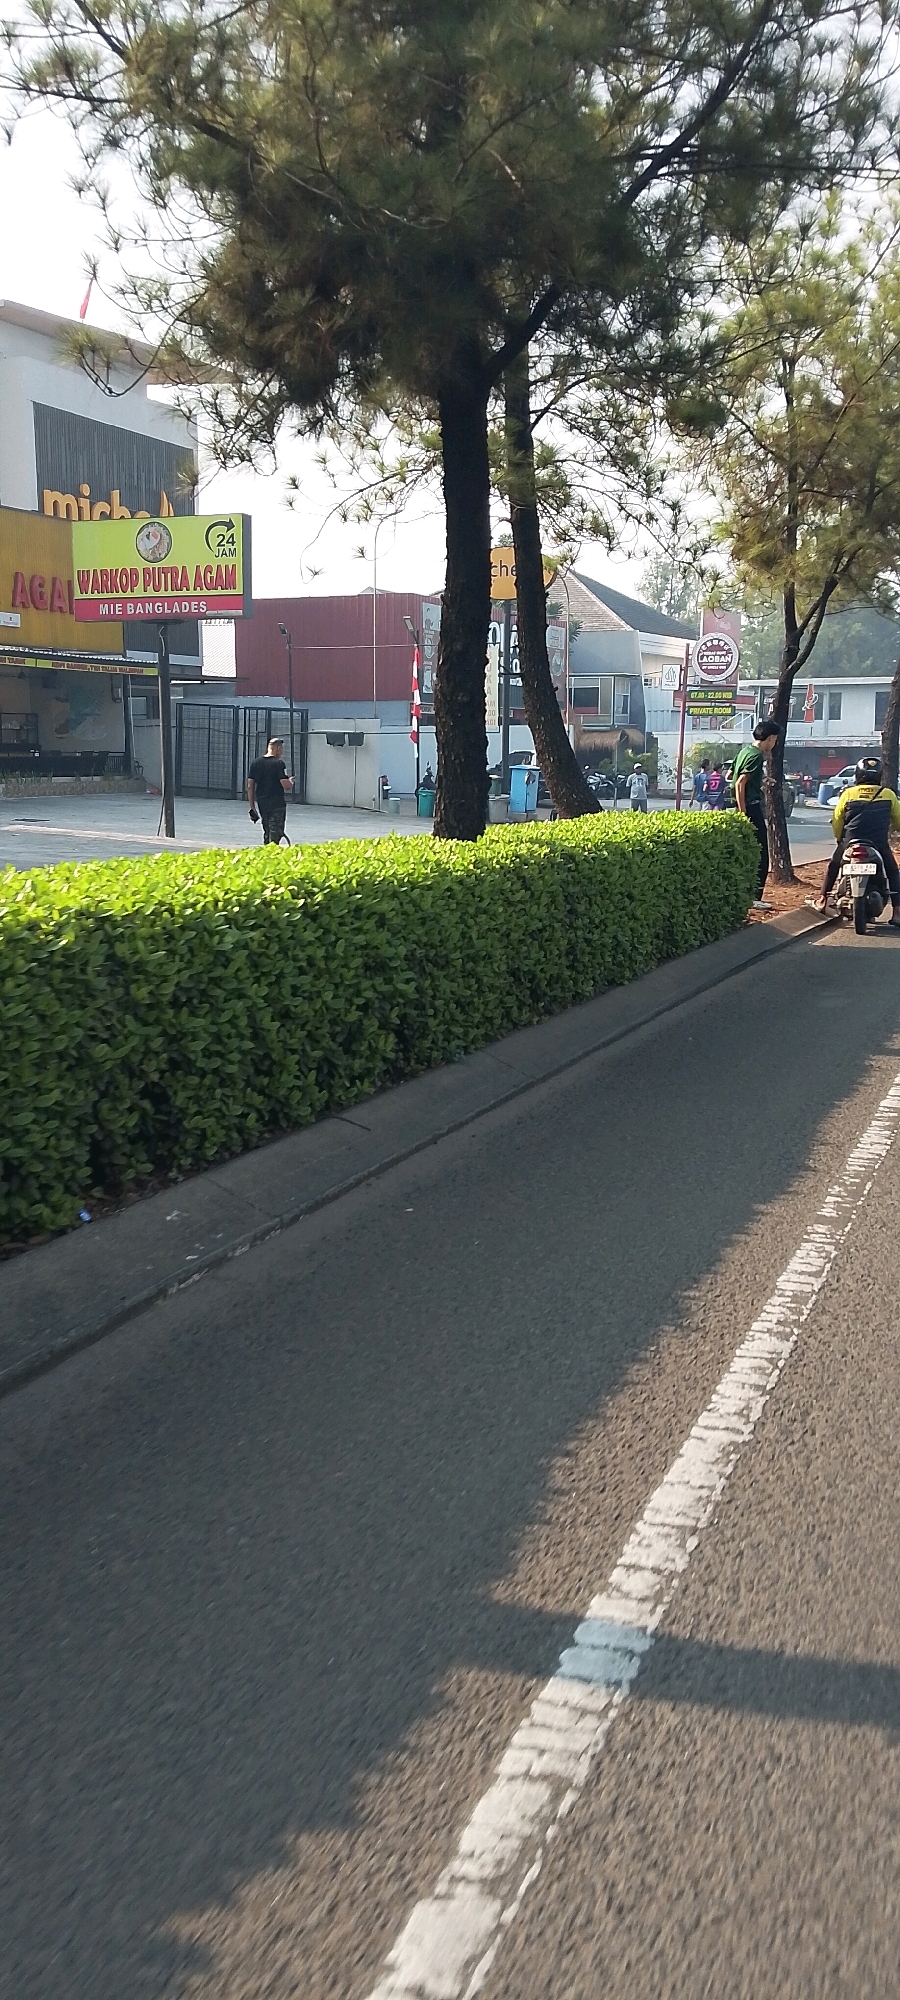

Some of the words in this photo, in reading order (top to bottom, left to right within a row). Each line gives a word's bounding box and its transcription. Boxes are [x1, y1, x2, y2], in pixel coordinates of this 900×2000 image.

[216, 533, 236, 548] 24
[214, 548, 237, 558] JAM
[77, 567, 139, 594] WARKOP
[142, 565, 190, 592] PUTRA
[193, 564, 237, 591] AGAM
[99, 603, 123, 615] MIE
[127, 600, 207, 615] BANGLADES
[698, 653, 733, 663] LAOBAN
[709, 780, 720, 790] 27
